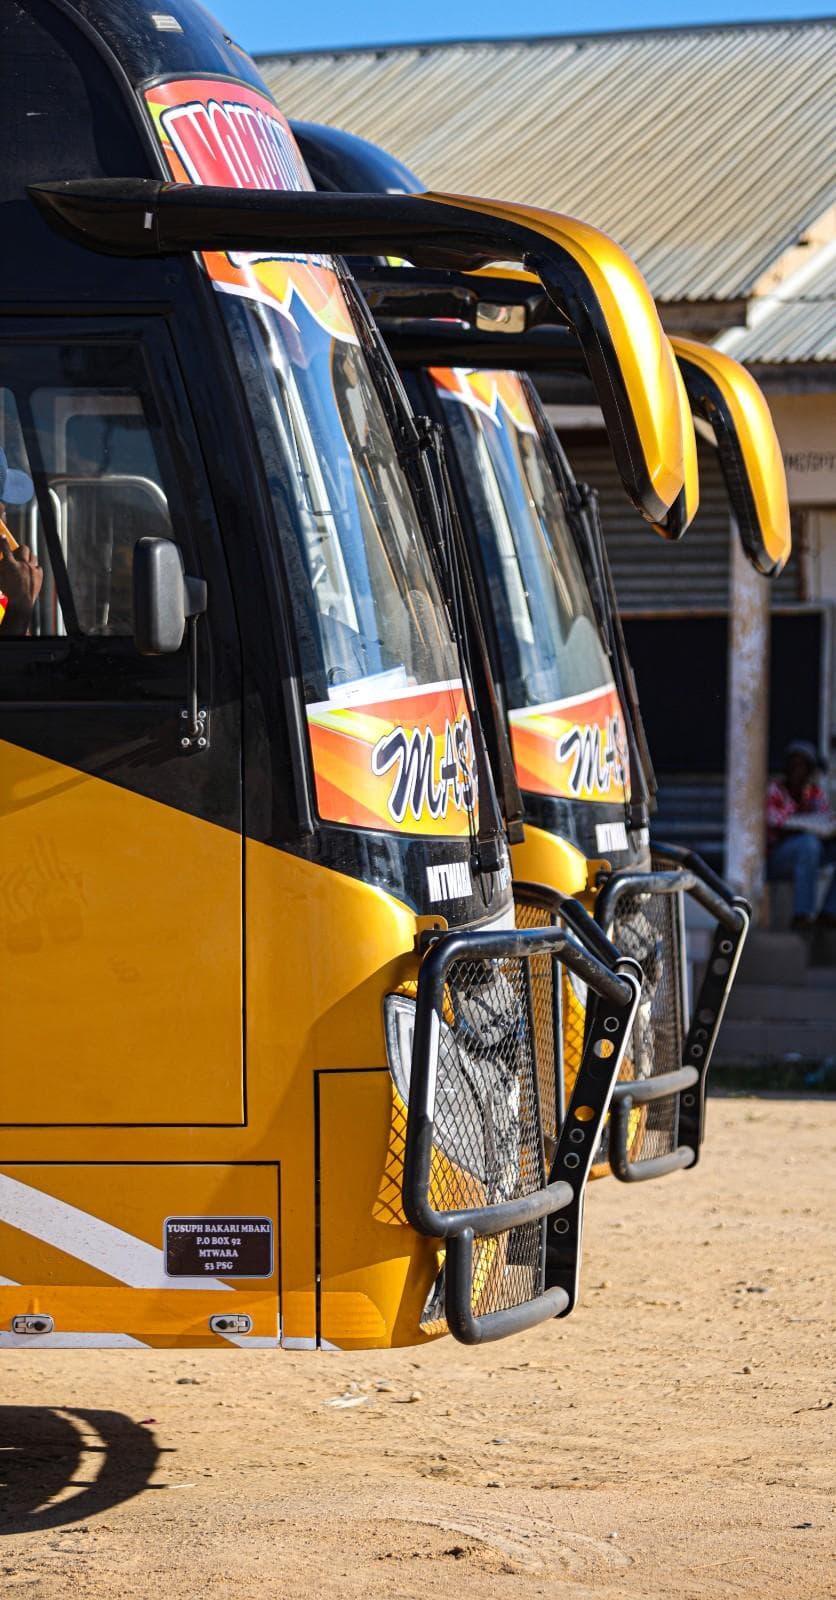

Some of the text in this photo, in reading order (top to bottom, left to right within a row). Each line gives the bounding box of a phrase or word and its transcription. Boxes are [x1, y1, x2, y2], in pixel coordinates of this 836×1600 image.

[372, 713, 478, 823] MAS
[168, 1224, 270, 1233] YUSUPH BAKARI MBAKI
[196, 1237, 210, 1245] P.O
[211, 1237, 230, 1245] BOX
[199, 1249, 239, 1258] MTWARA
[204, 1261, 234, 1271] 53 PSG
